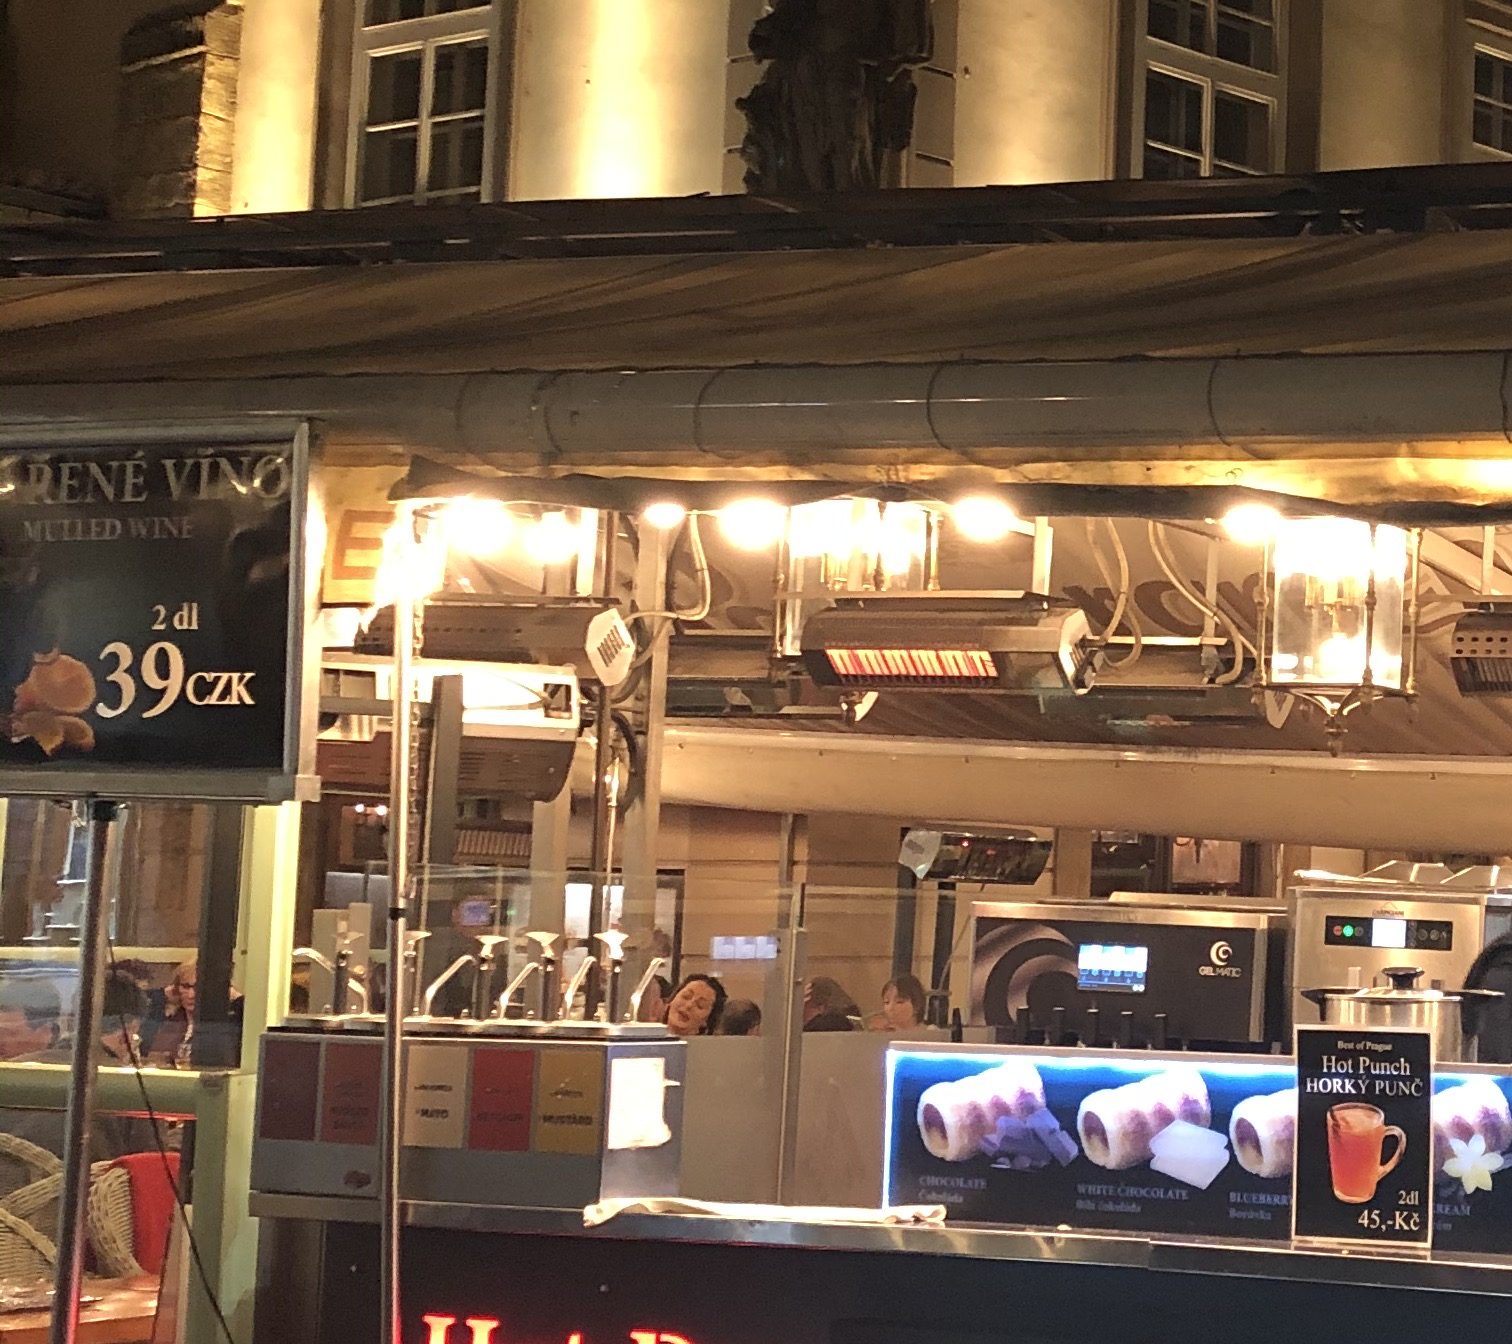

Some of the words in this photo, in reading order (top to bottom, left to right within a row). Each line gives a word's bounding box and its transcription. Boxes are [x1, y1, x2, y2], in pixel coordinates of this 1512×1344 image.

[22, 518, 122, 542] MULLED
[127, 516, 193, 540] WINE
[151, 605, 166, 630] 2
[173, 602, 199, 630] dl
[96, 641, 185, 719] 39
[185, 672, 256, 705] CZK
[1322, 1055, 1353, 1074] Hot
[1359, 1056, 1411, 1076] Punch
[1306, 1074, 1371, 1095] HORKÝ
[1375, 1078, 1424, 1097] PUNČ
[918, 1175, 987, 1190] CHOCOLATE
[1076, 1183, 1116, 1197] WHITE
[1117, 1186, 1189, 1201] CHOCOLATE
[1229, 1191, 1288, 1206] BLUEBERR
[1398, 1190, 1419, 1206] 2dl
[1357, 1209, 1420, 1232] 45,-Kč
[1435, 1204, 1471, 1216] REAM
